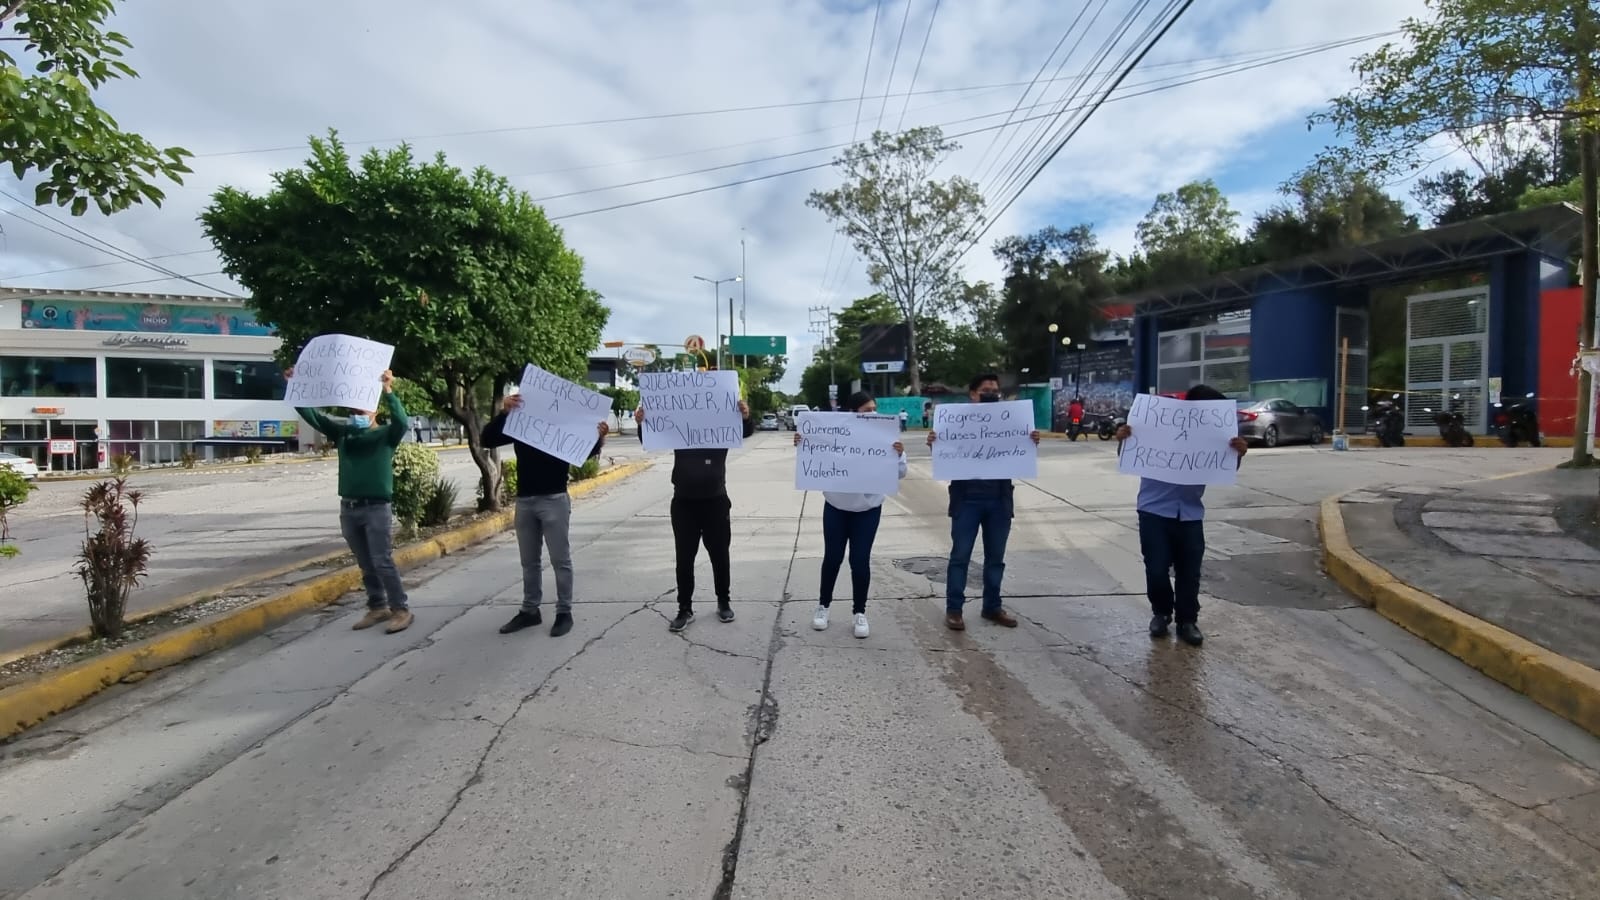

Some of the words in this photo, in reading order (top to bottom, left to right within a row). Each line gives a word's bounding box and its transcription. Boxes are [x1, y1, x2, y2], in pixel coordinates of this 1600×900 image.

[298, 360, 326, 378] QUE
[333, 361, 374, 378] NOS
[640, 372, 717, 391] QUEREMOS
[289, 380, 376, 402] REUBIQUEN
[548, 398, 560, 414] A
[641, 392, 721, 414] APRENDER,
[725, 391, 740, 413] N
[645, 416, 675, 433] NOS
[938, 409, 992, 429] Regreso
[802, 420, 851, 437] Queremos
[980, 424, 1030, 440] Presencial
[1174, 430, 1189, 441] A
[849, 445, 865, 457] no,
[868, 447, 887, 457] nos
[1119, 435, 1233, 471] PRESENCIAL
[802, 460, 849, 479] Violenten
